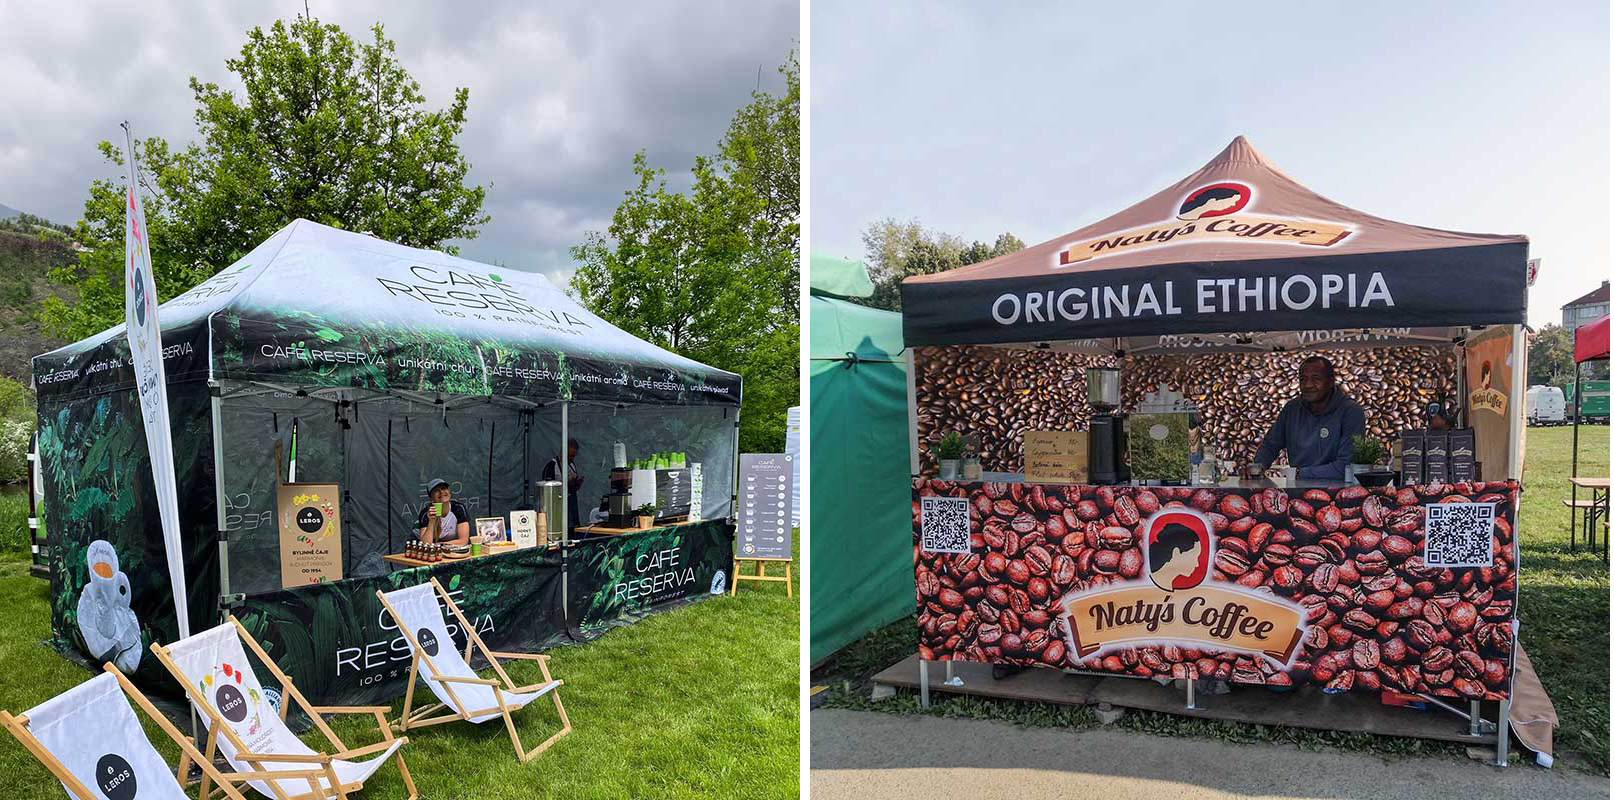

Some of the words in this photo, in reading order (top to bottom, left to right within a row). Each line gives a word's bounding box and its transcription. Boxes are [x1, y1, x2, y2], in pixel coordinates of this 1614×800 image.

[1206, 219, 1317, 239] Coffee
[376, 277, 592, 328] RESERVA
[992, 279, 1182, 325] ORIGINAL
[1196, 272, 1396, 315] ETHIOPIA
[312, 349, 386, 366] RESERVA
[515, 367, 563, 381] RESERVA
[653, 380, 685, 392] RESERVA
[615, 566, 696, 603] RESERVA
[1182, 596, 1274, 640] Coffee
[421, 638, 436, 649] LEROS
[222, 697, 242, 713] LEROS
[104, 769, 130, 792] LEROS
